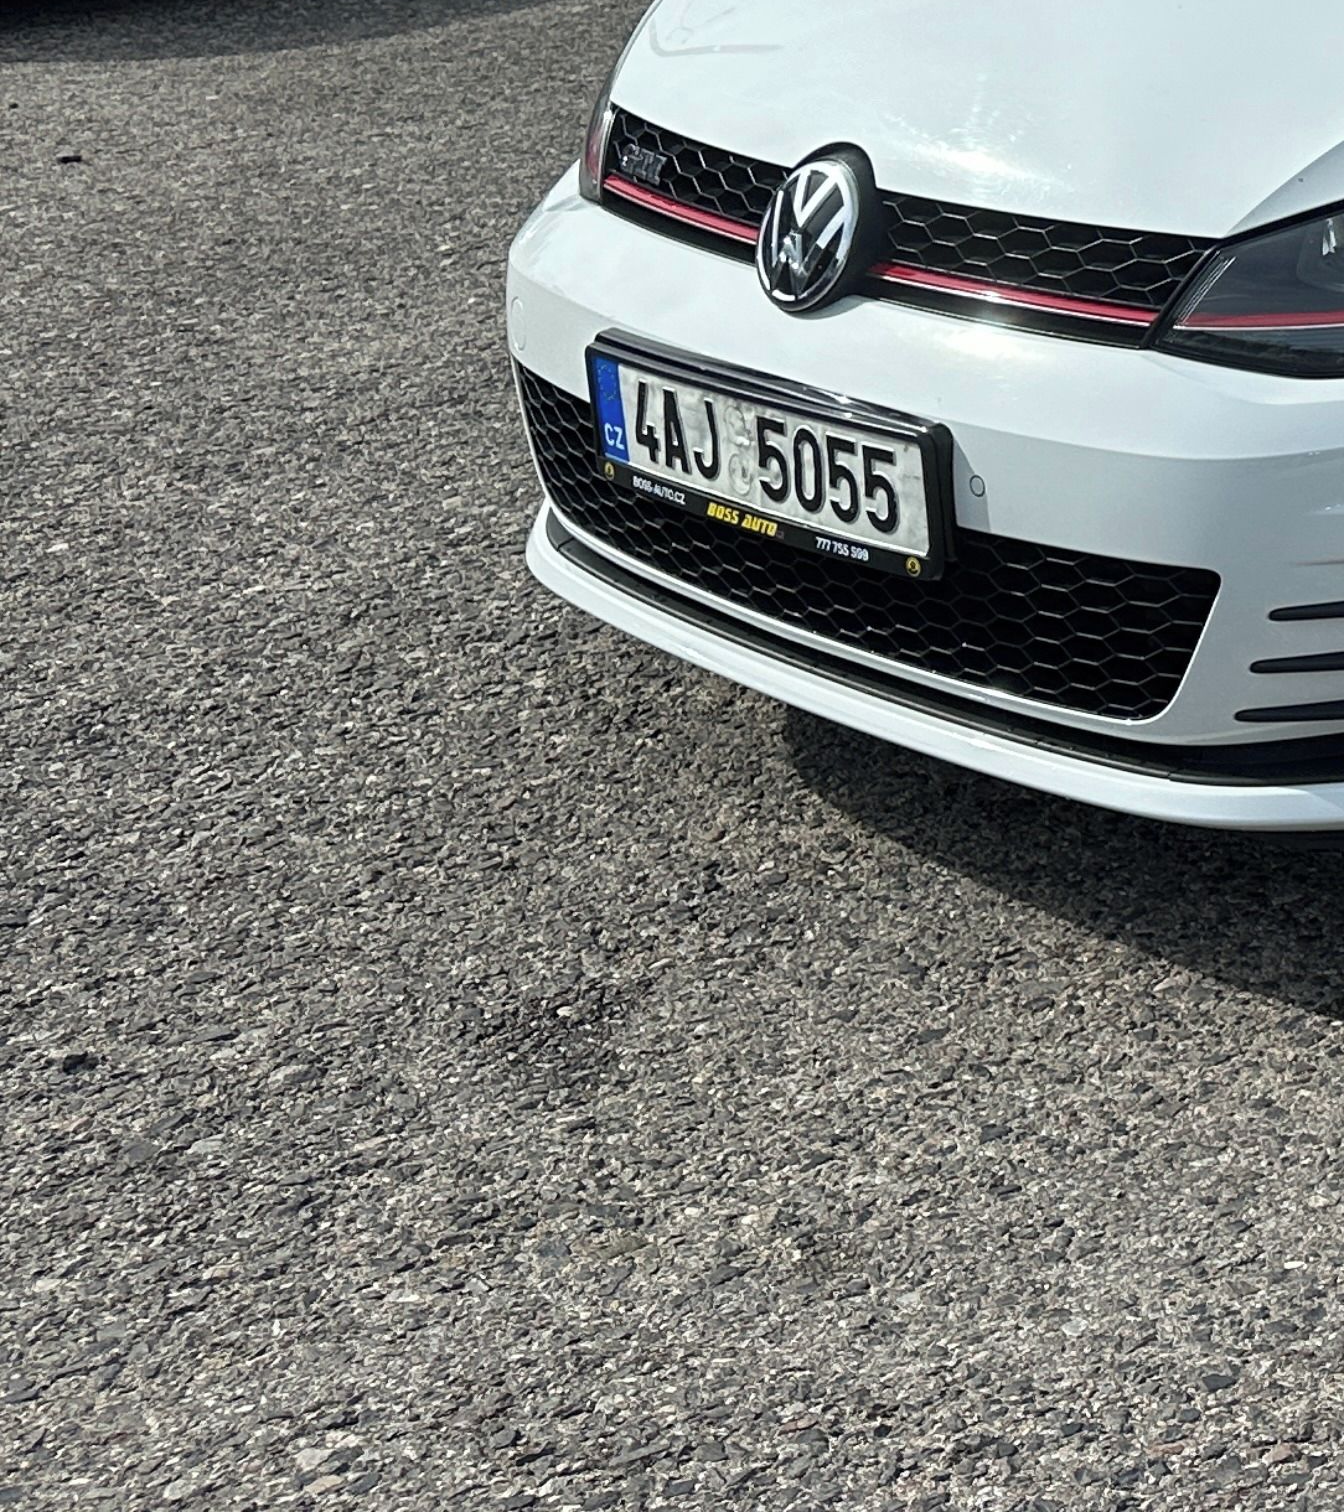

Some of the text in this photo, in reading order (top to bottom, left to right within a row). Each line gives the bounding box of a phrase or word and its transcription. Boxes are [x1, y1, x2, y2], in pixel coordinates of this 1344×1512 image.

[604, 423, 625, 451] CZ
[635, 378, 900, 535] 4AJ 5055
[707, 501, 778, 538] BOSS AUTO
[815, 536, 832, 551] 777
[832, 540, 849, 556] 755
